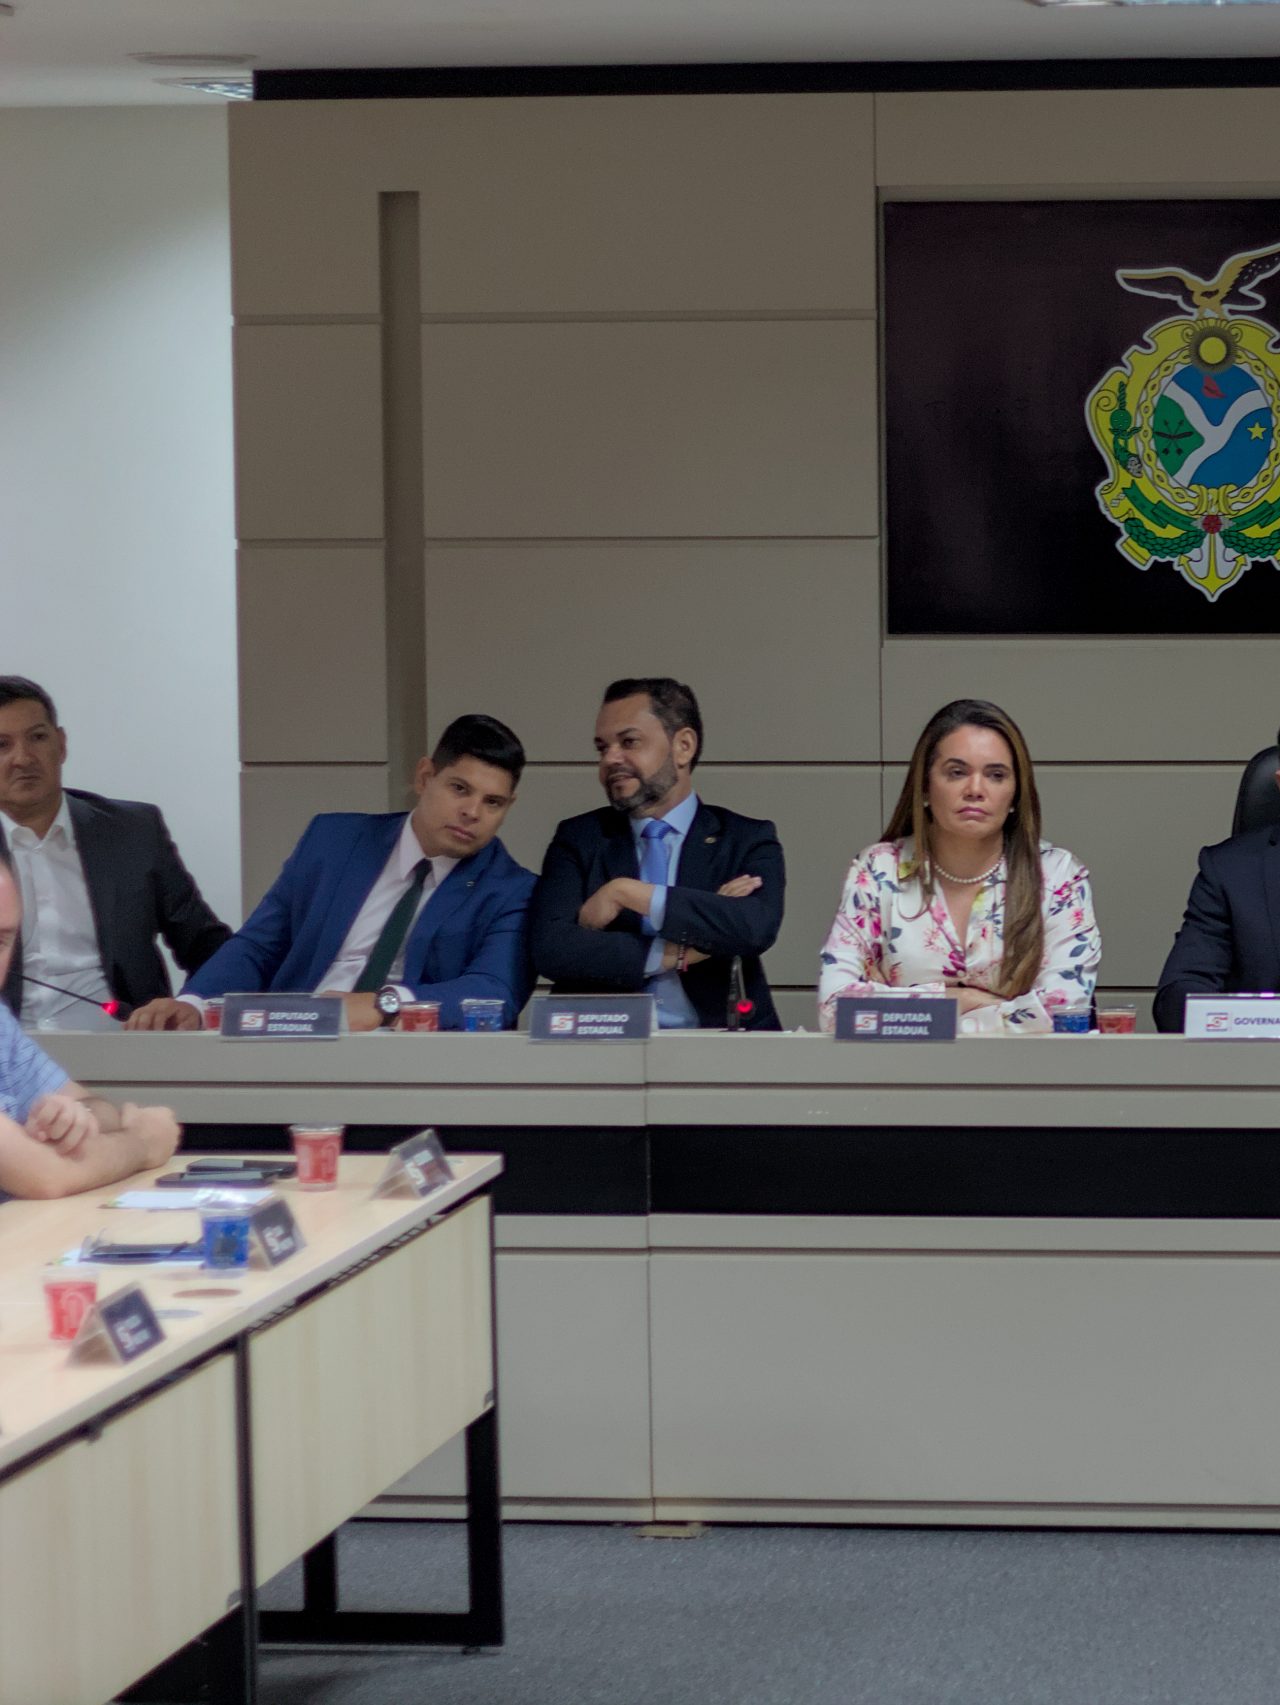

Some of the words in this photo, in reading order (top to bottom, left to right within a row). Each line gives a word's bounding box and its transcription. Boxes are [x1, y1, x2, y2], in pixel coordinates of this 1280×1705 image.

[269, 1011, 318, 1021] DEPUTADO
[577, 1013, 629, 1023] DEPUTADO
[882, 1012, 932, 1023] DEPUTADA
[267, 1023, 313, 1032] ESTADUAL
[577, 1025, 624, 1035] ESTADUAL
[881, 1025, 930, 1035] ESTADUAL
